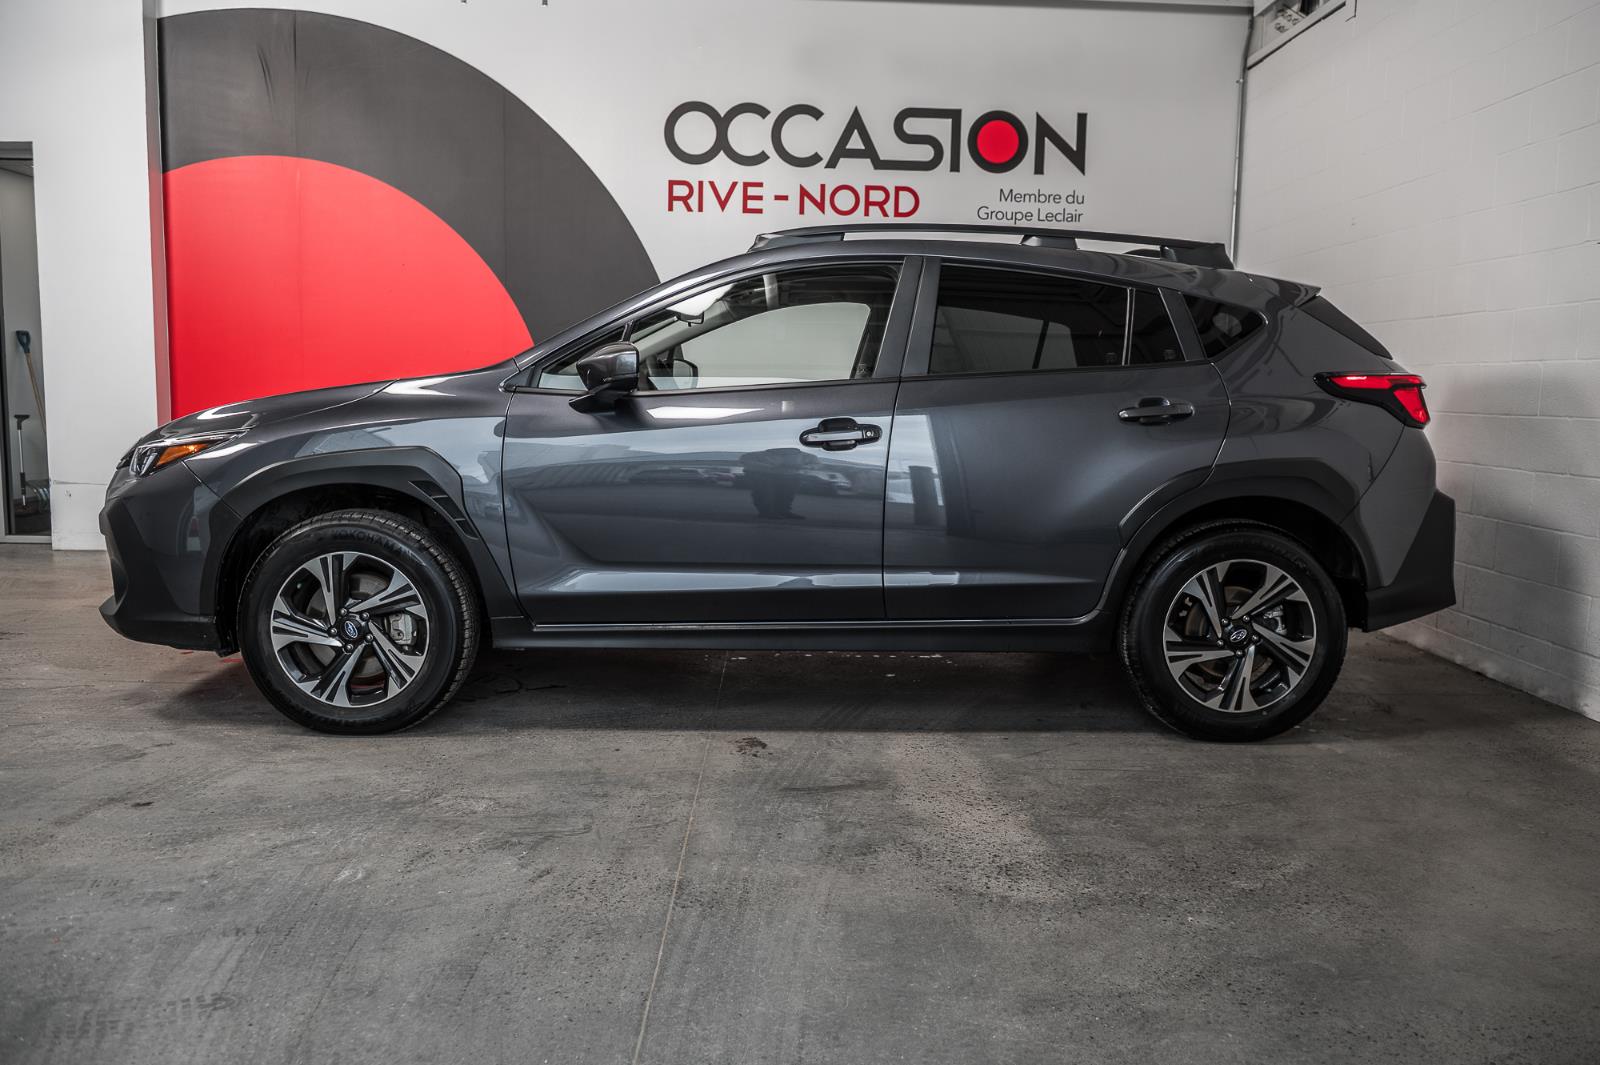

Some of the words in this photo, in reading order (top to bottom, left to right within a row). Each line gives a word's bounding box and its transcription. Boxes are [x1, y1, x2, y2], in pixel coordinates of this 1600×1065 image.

[664, 101, 1088, 176] OCCASION
[1000, 188, 1062, 204] Membre
[1065, 190, 1085, 205] du
[977, 205, 1033, 225] Groupe
[1037, 208, 1084, 223] Leclair
